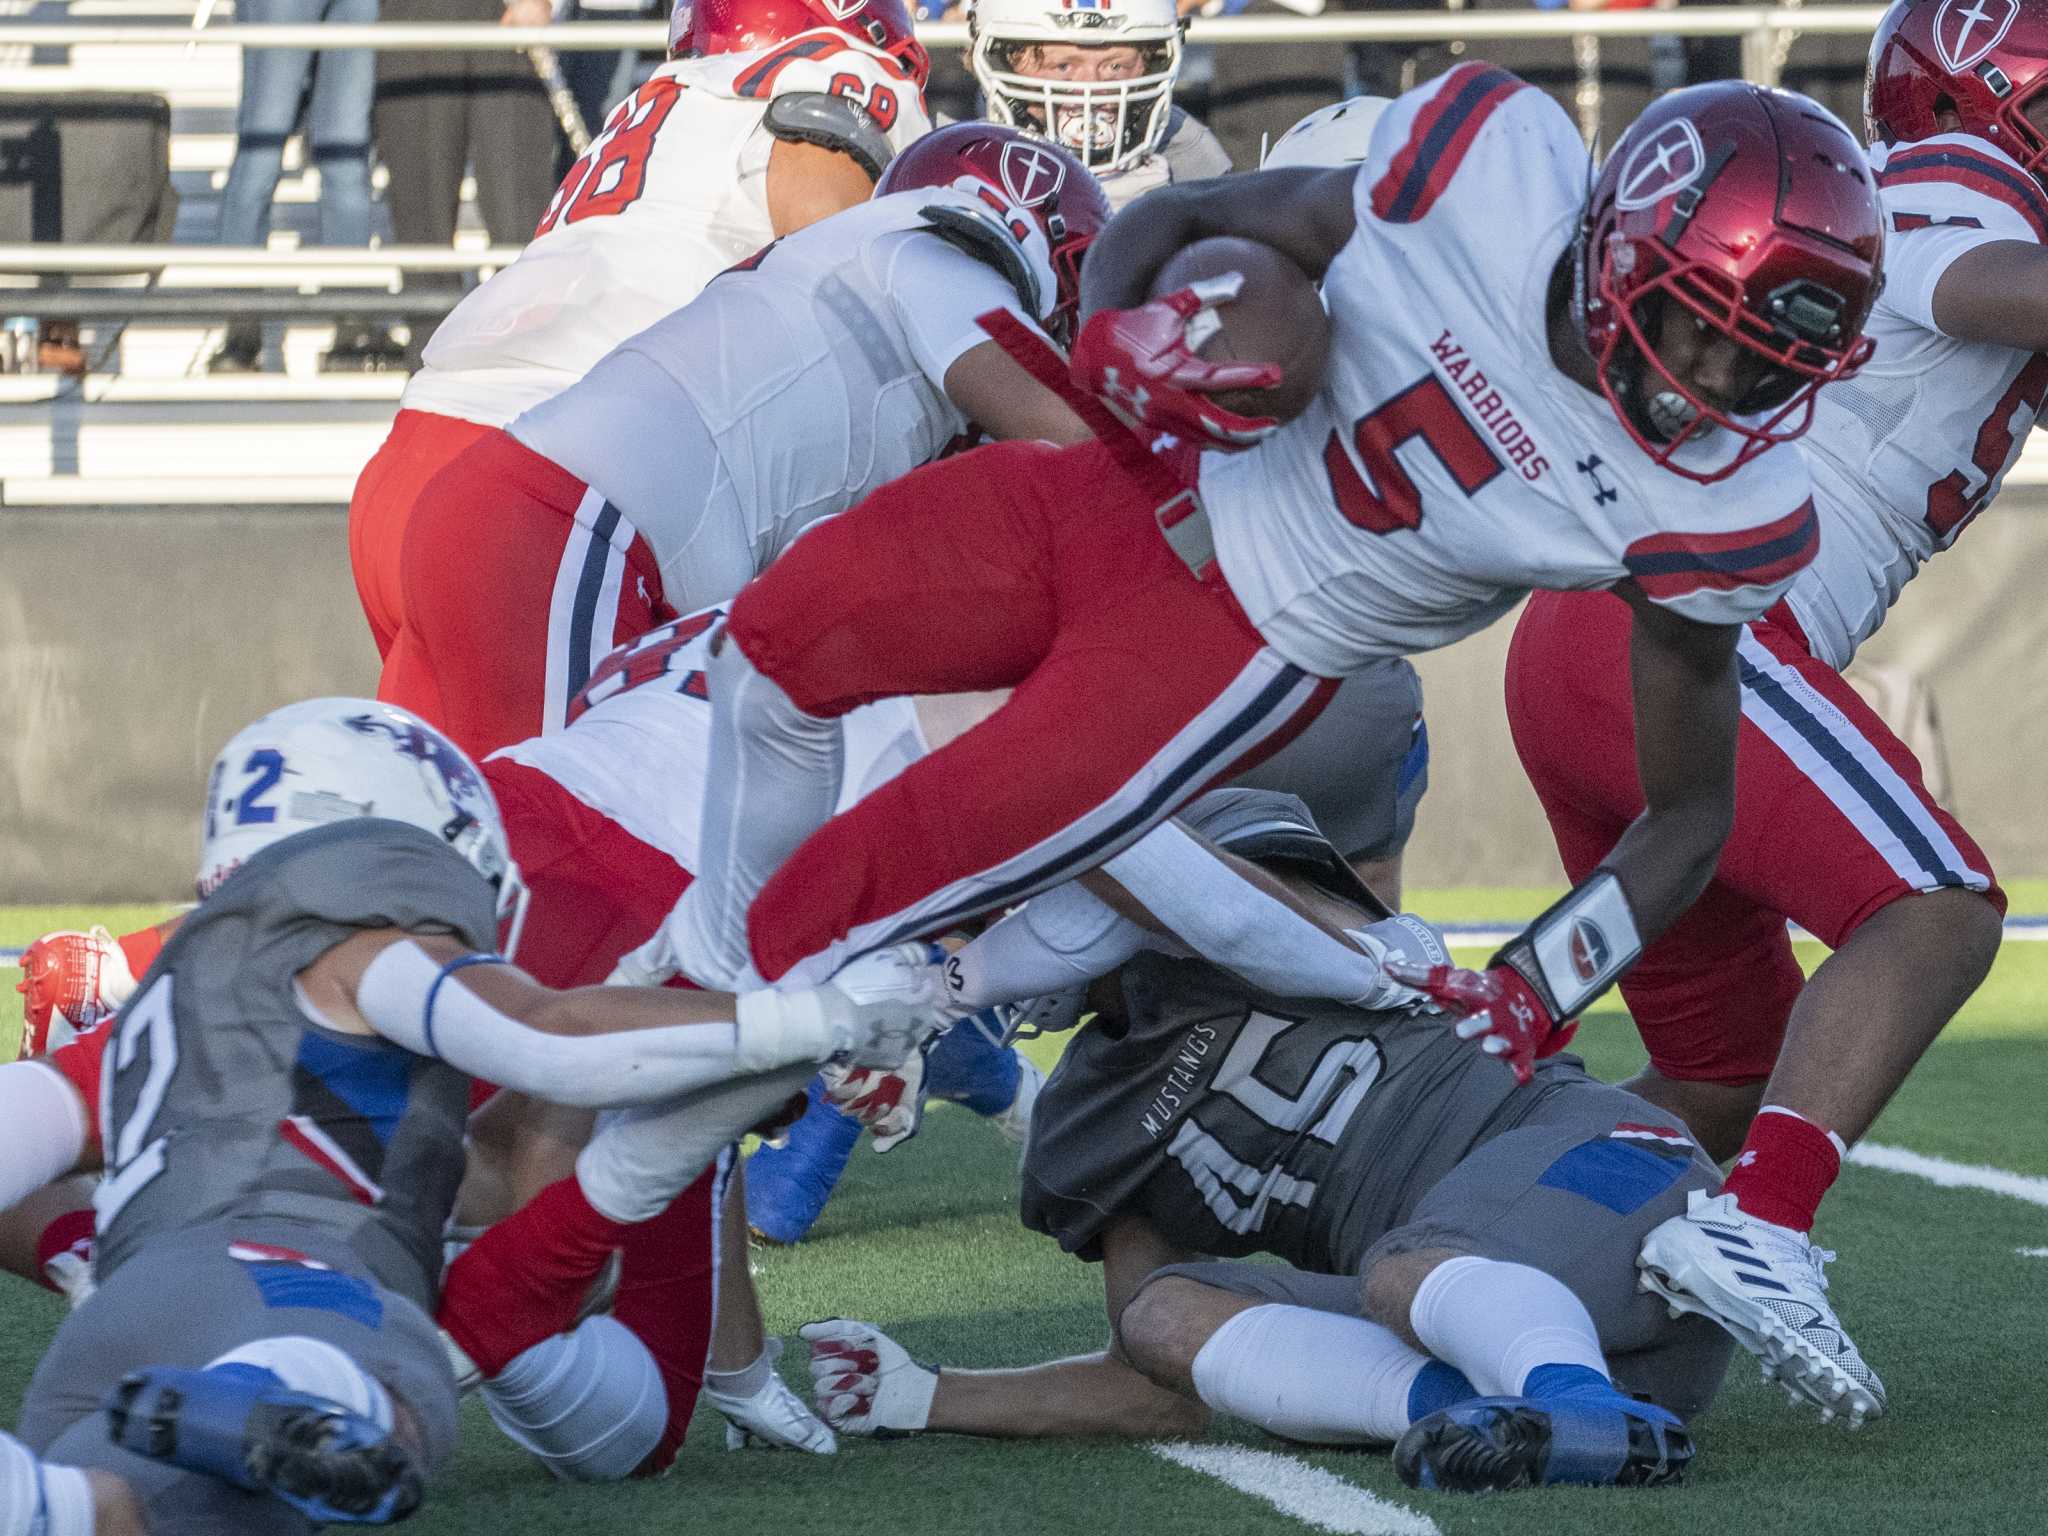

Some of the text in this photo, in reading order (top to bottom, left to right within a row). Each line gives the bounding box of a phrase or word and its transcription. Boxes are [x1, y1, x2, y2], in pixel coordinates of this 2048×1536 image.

[1322, 371, 1507, 536] 5
[1429, 329, 1551, 481] WARRIORS
[1140, 1023, 1218, 1141] MUSTANGS
